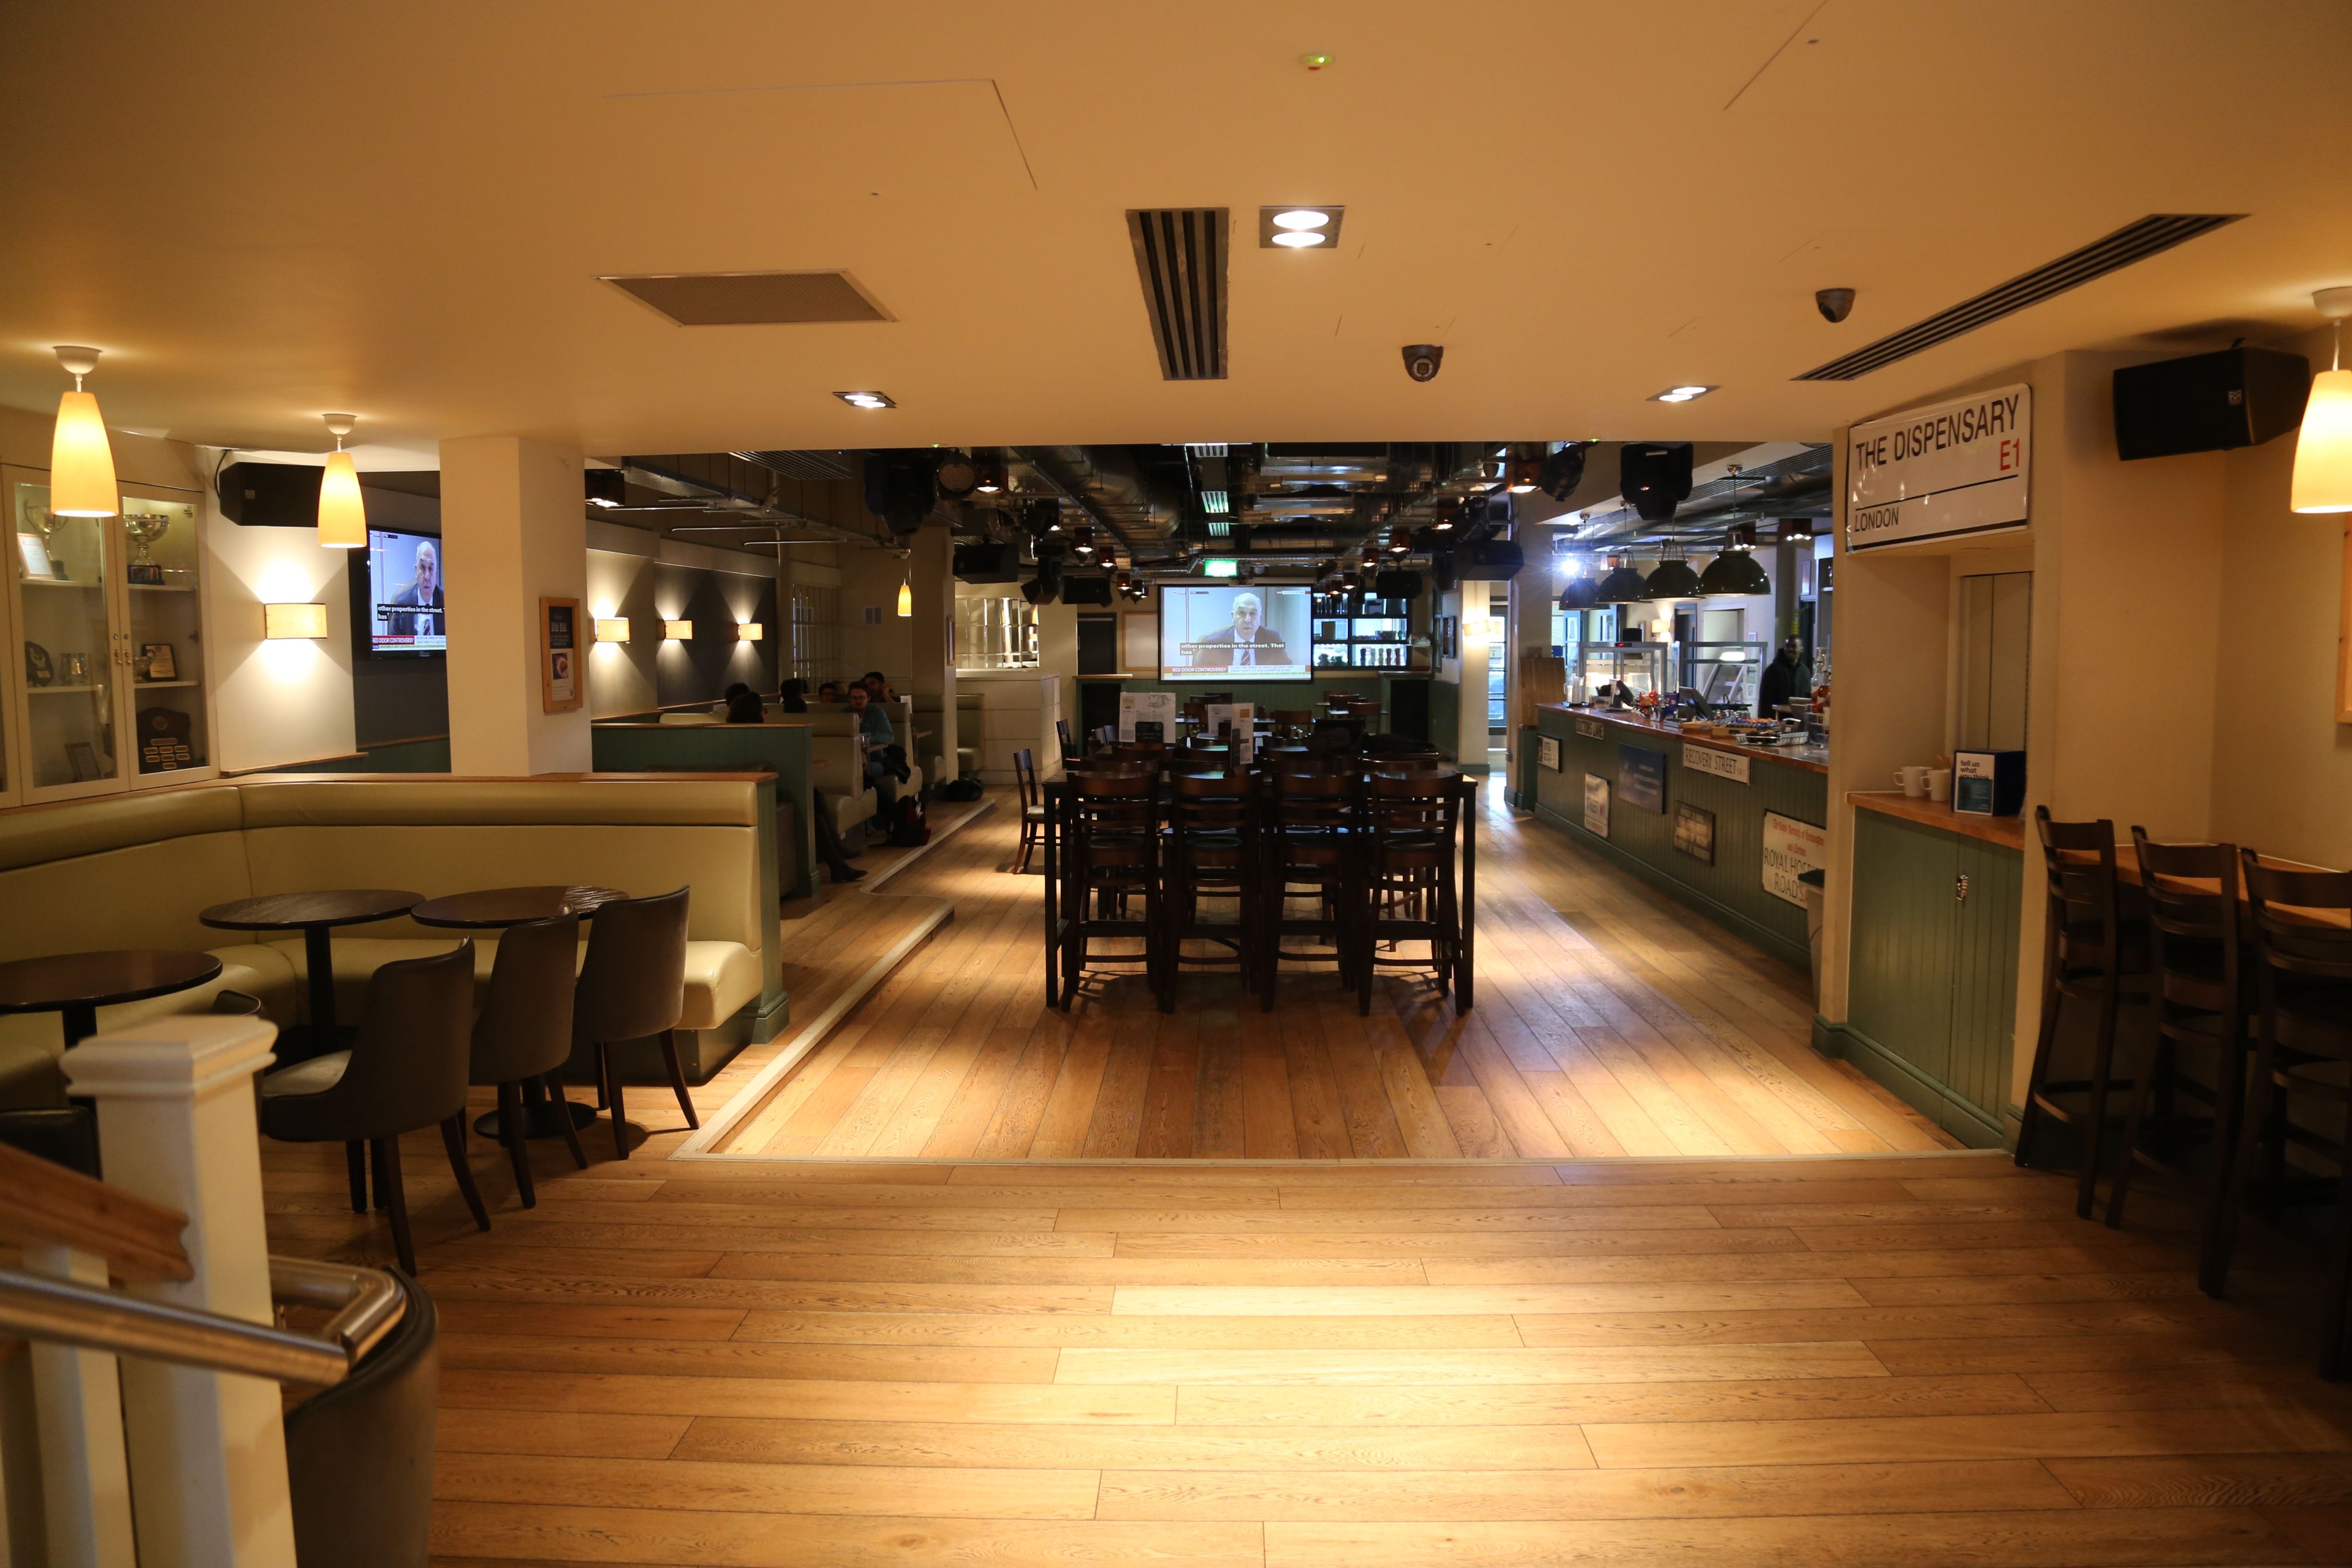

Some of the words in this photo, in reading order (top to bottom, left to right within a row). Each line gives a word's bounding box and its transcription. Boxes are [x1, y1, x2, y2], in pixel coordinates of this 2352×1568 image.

[1856, 436, 1887, 471] THE
[1895, 394, 2019, 461] DISPENSARY
[2000, 438, 2020, 471] E1
[1855, 507, 1899, 532] LONDON
[1577, 719, 1591, 735] DOCTORS
[1593, 723, 1603, 738] LANE
[1685, 747, 1712, 769] RECOVERY
[1715, 755, 1737, 774] STREET
[1764, 847, 1789, 873] ROYAL
[1774, 872, 1798, 899] ROAD
